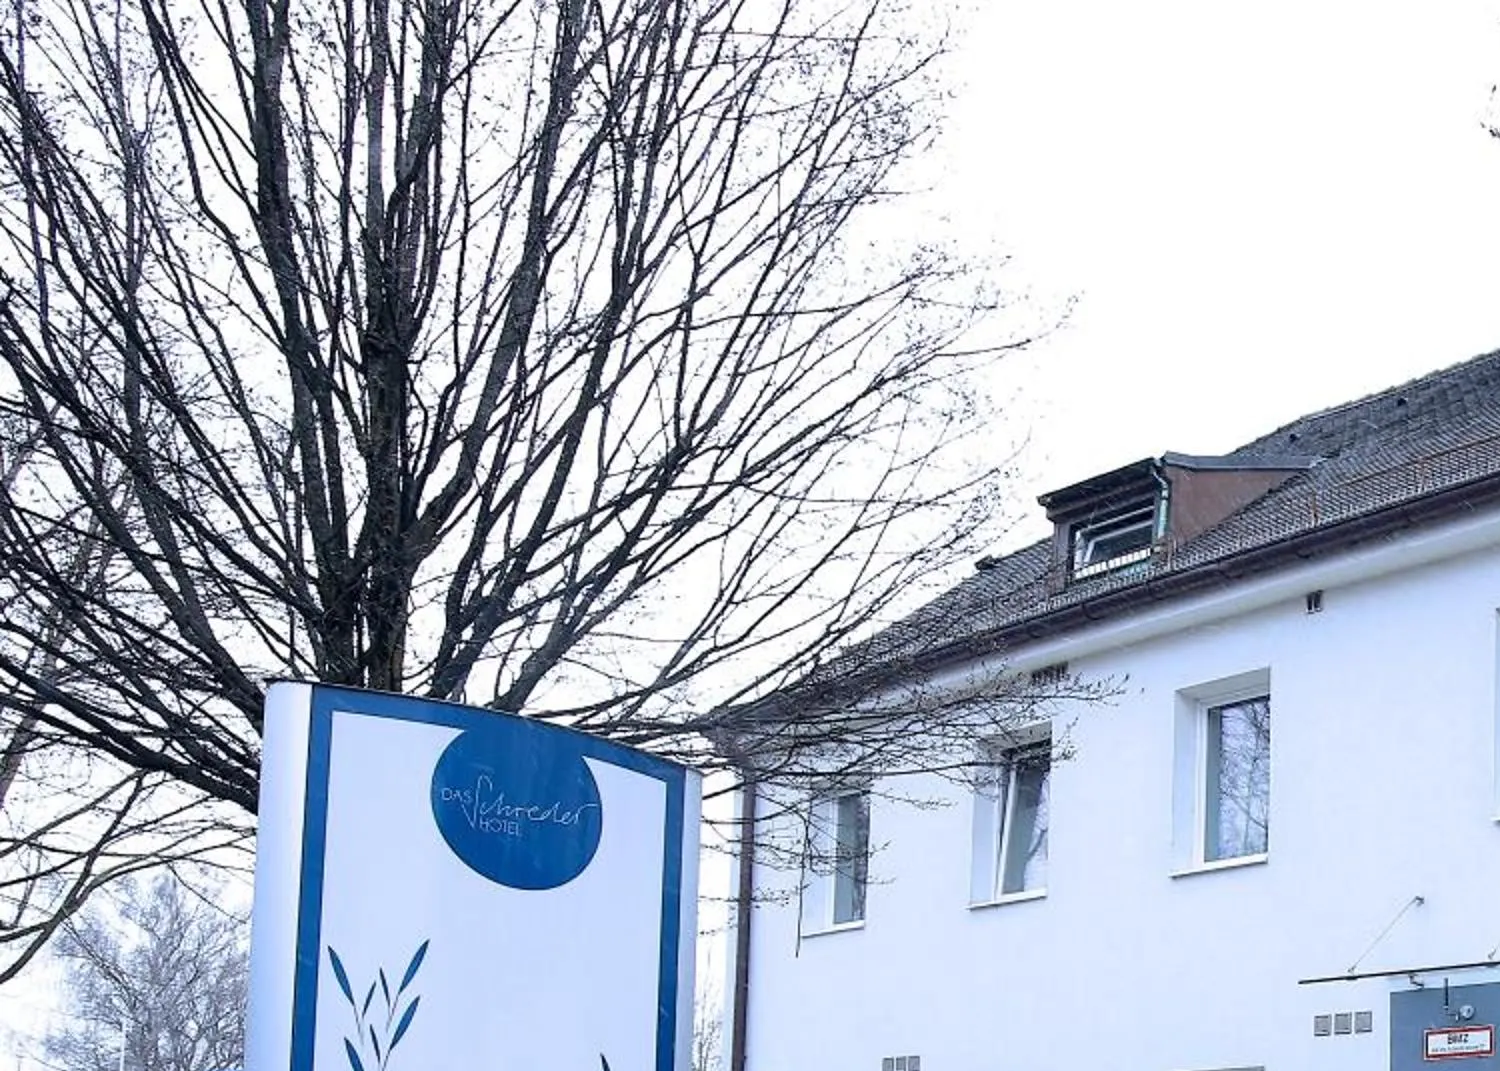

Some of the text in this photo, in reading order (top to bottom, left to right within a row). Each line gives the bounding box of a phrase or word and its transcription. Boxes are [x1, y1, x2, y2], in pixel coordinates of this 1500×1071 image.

[441, 775, 598, 828] DAS Schreder
[479, 817, 519, 836] HOTEL
